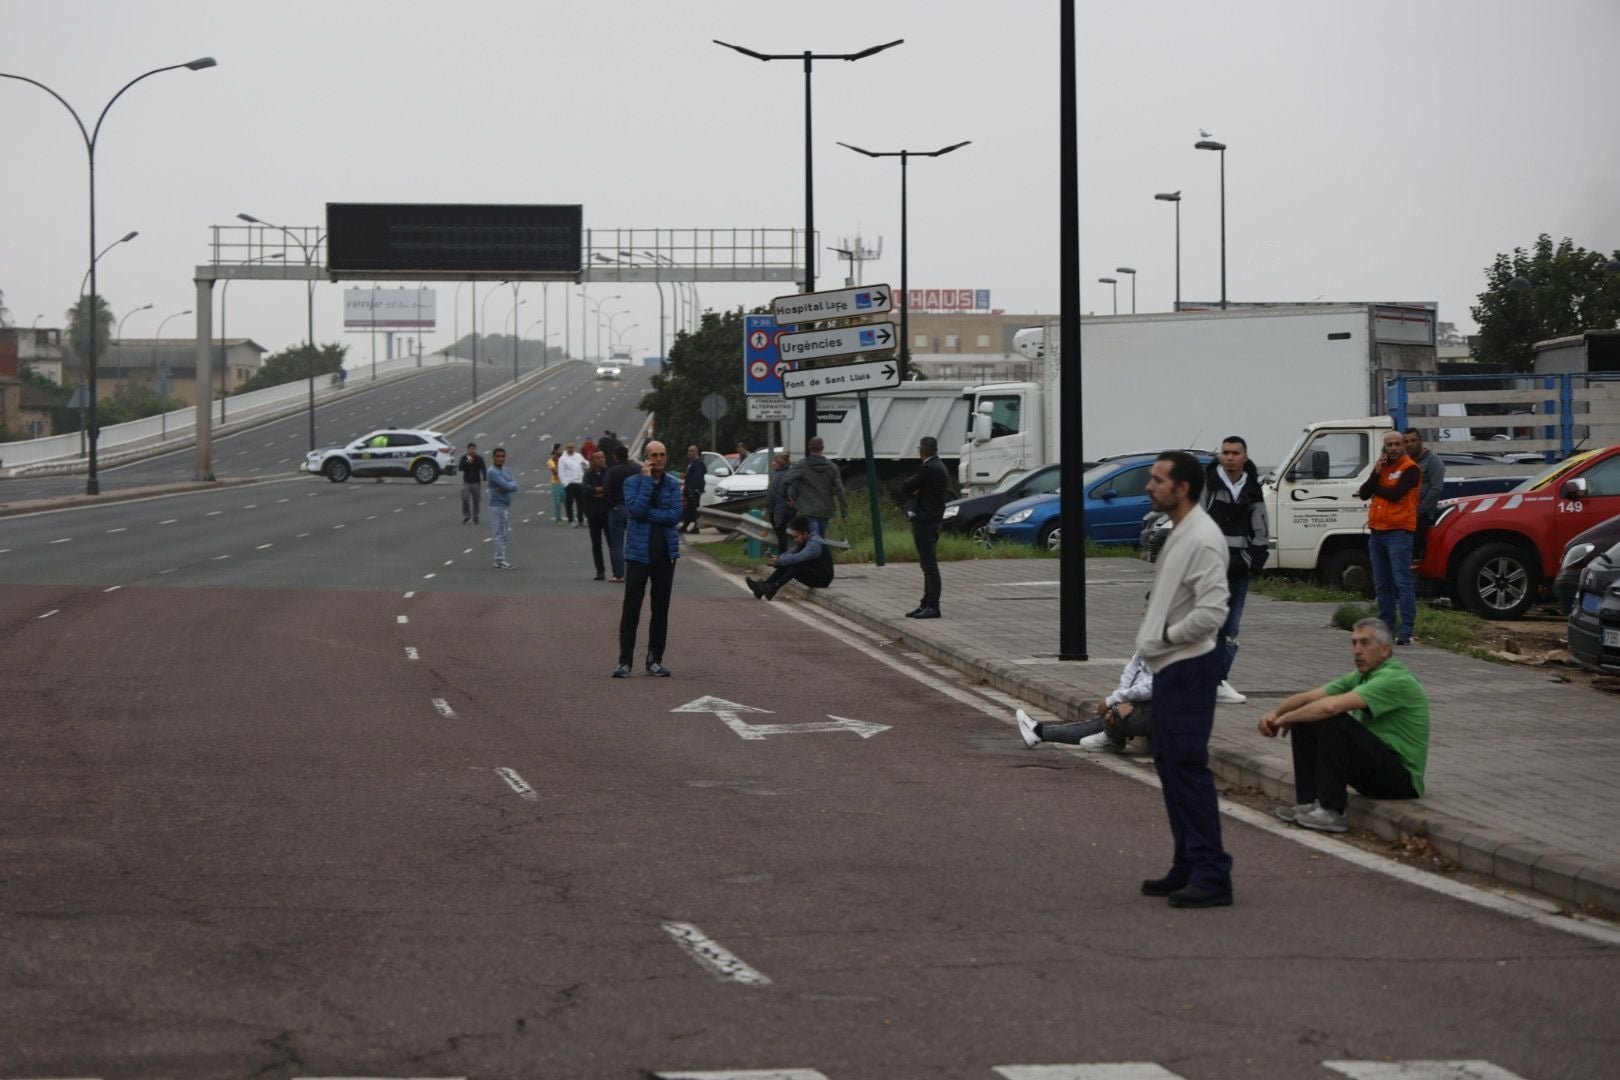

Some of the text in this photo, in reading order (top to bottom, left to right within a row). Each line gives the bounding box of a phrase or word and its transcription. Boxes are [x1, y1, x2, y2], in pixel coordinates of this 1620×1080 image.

[777, 301, 824, 315] Hospital
[781, 338, 843, 353] Urgències
[785, 380, 805, 389] Font
[809, 379, 821, 387] de
[825, 376, 846, 385] Sant
[1558, 501, 1583, 512] 149
